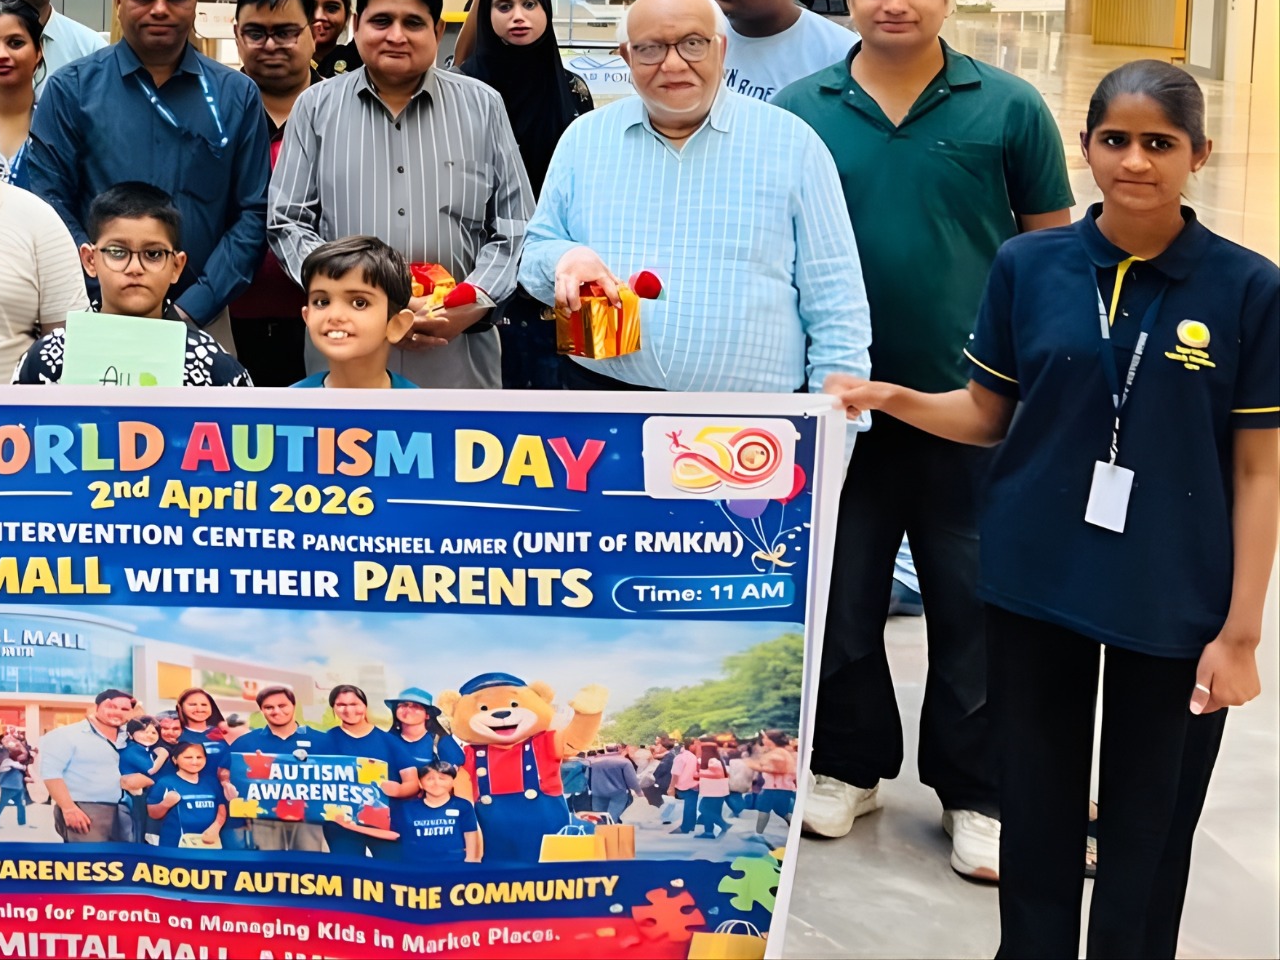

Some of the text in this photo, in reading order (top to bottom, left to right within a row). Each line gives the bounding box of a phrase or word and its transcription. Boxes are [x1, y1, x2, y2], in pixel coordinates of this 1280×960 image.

[181, 421, 434, 479] AUTISM
[454, 428, 606, 492] DAY
[87, 475, 375, 518] 2nd April 2026
[192, 525, 296, 550] CENTER
[302, 533, 435, 554] PANCHSHEEL
[440, 537, 508, 555] AJMER
[513, 530, 593, 558] (UNIT
[634, 530, 745, 558] RMKM)
[124, 566, 220, 594] WITH
[230, 568, 340, 598] THEIR
[353, 560, 594, 609] PARENTS
[632, 580, 785, 603] Time: 11 AM
[21, 628, 87, 650] MALL
[269, 762, 355, 783] AUTISM
[247, 781, 374, 805] AWARENESS
[131, 862, 228, 891] ABOUT
[234, 871, 343, 897] AUTISM
[352, 877, 384, 904] IN
[390, 882, 442, 910] THE
[449, 875, 620, 907] COMMUNITY
[45, 903, 75, 921] for
[168, 914, 193, 930] on
[200, 914, 310, 941] Managing
[317, 921, 366, 944] Kids
[373, 928, 395, 950] in
